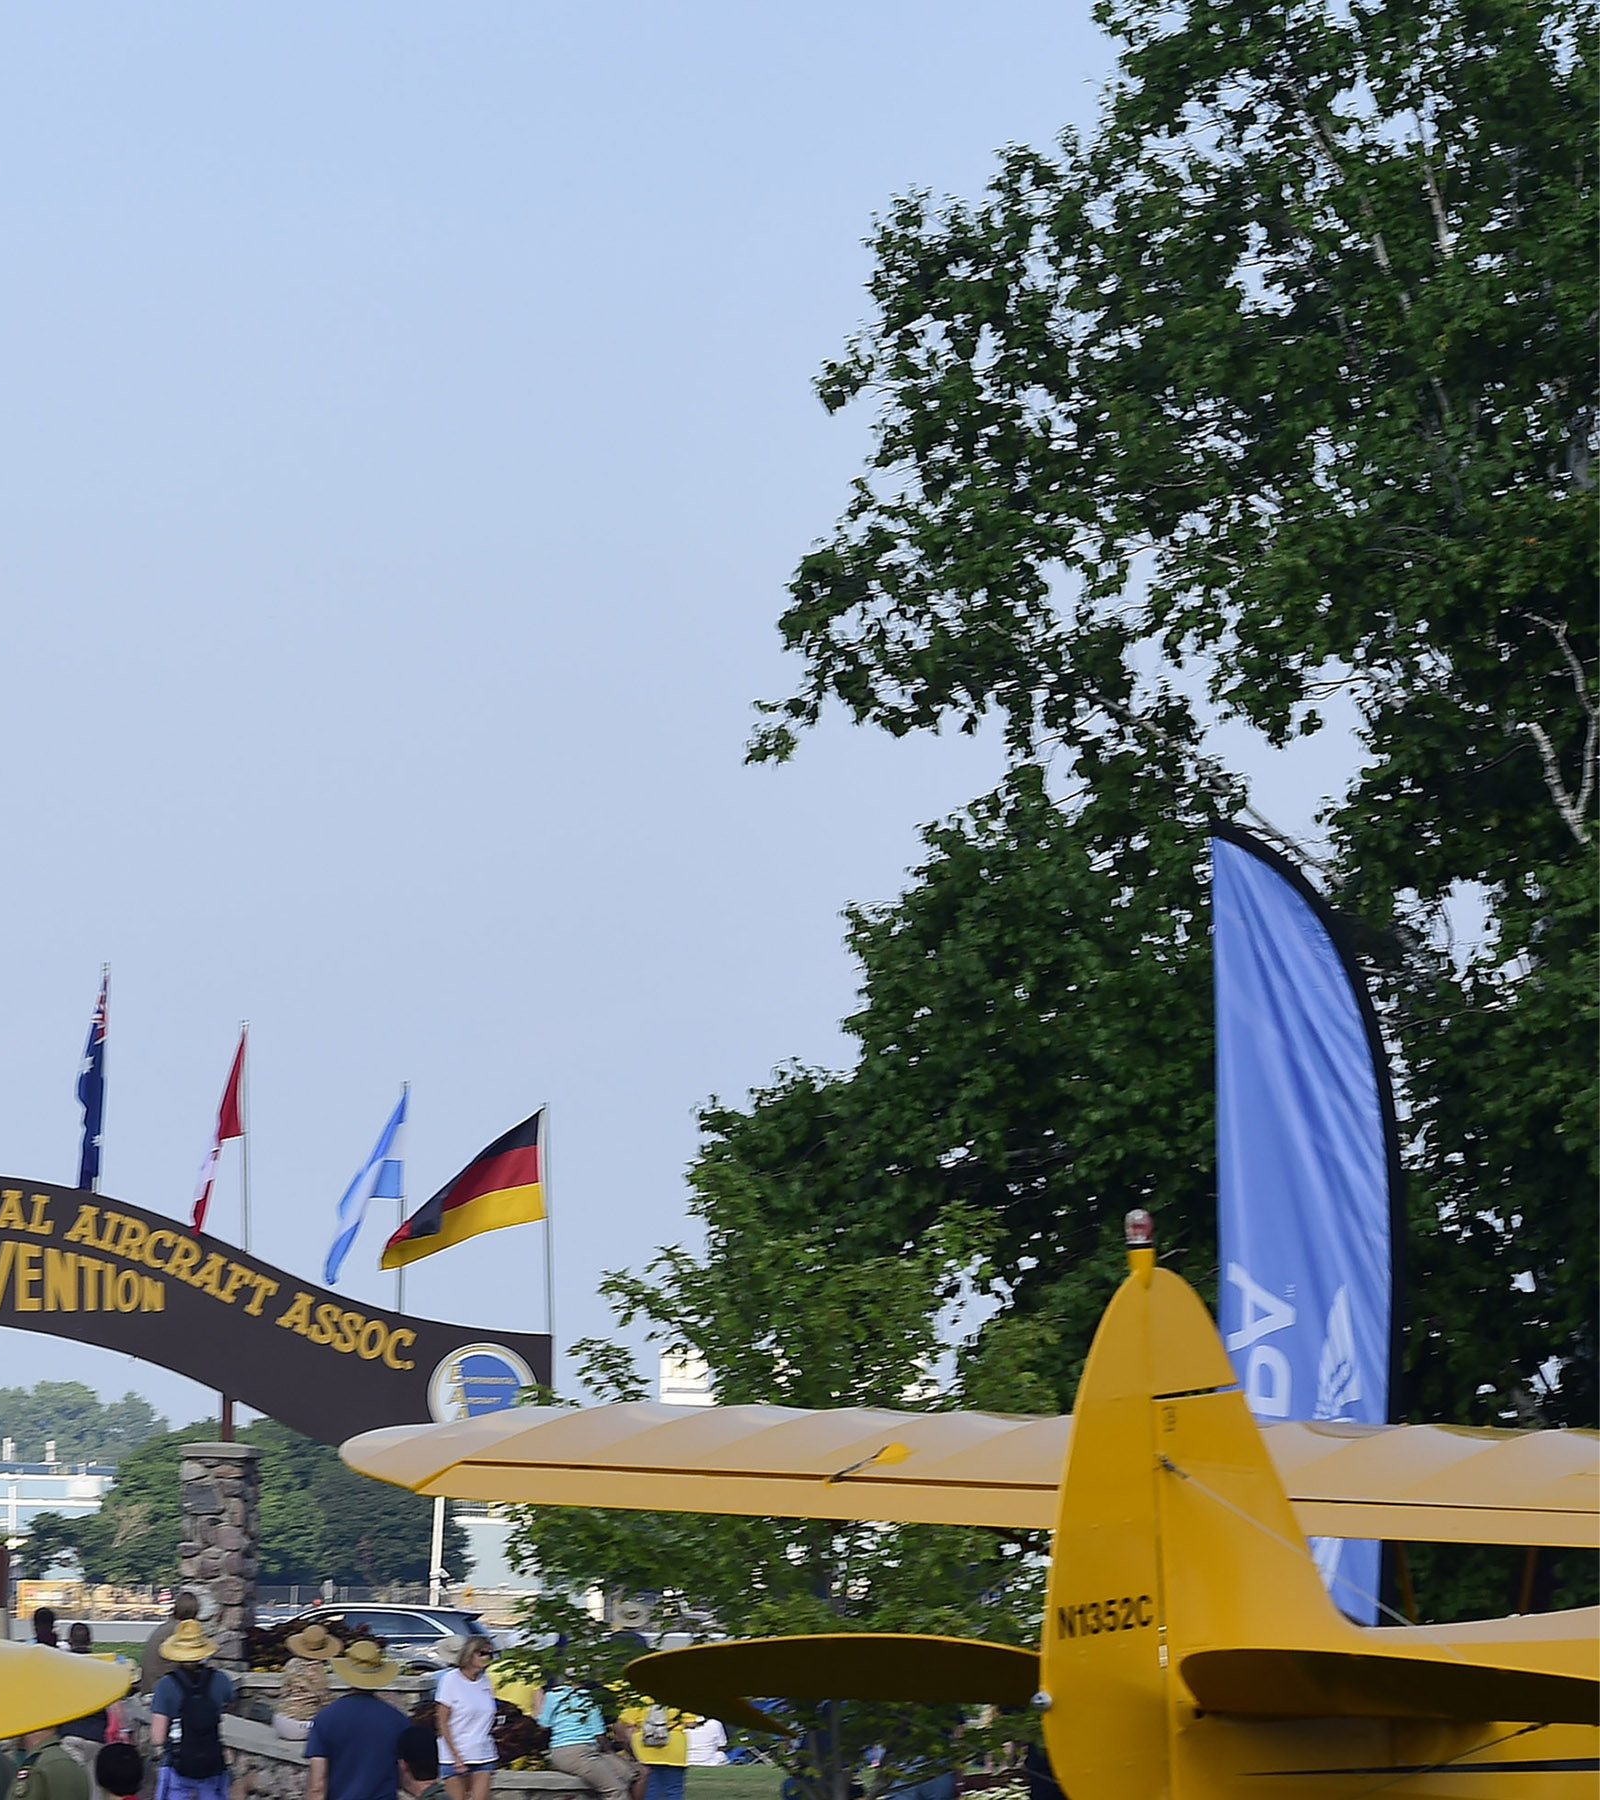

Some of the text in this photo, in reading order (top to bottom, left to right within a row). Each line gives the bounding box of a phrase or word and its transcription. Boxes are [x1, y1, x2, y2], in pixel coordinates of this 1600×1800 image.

[63, 1204, 280, 1316] AIRCRAFT
[276, 1292, 417, 1371] ASSOC.
[1057, 1595, 1154, 1640] N1352C
